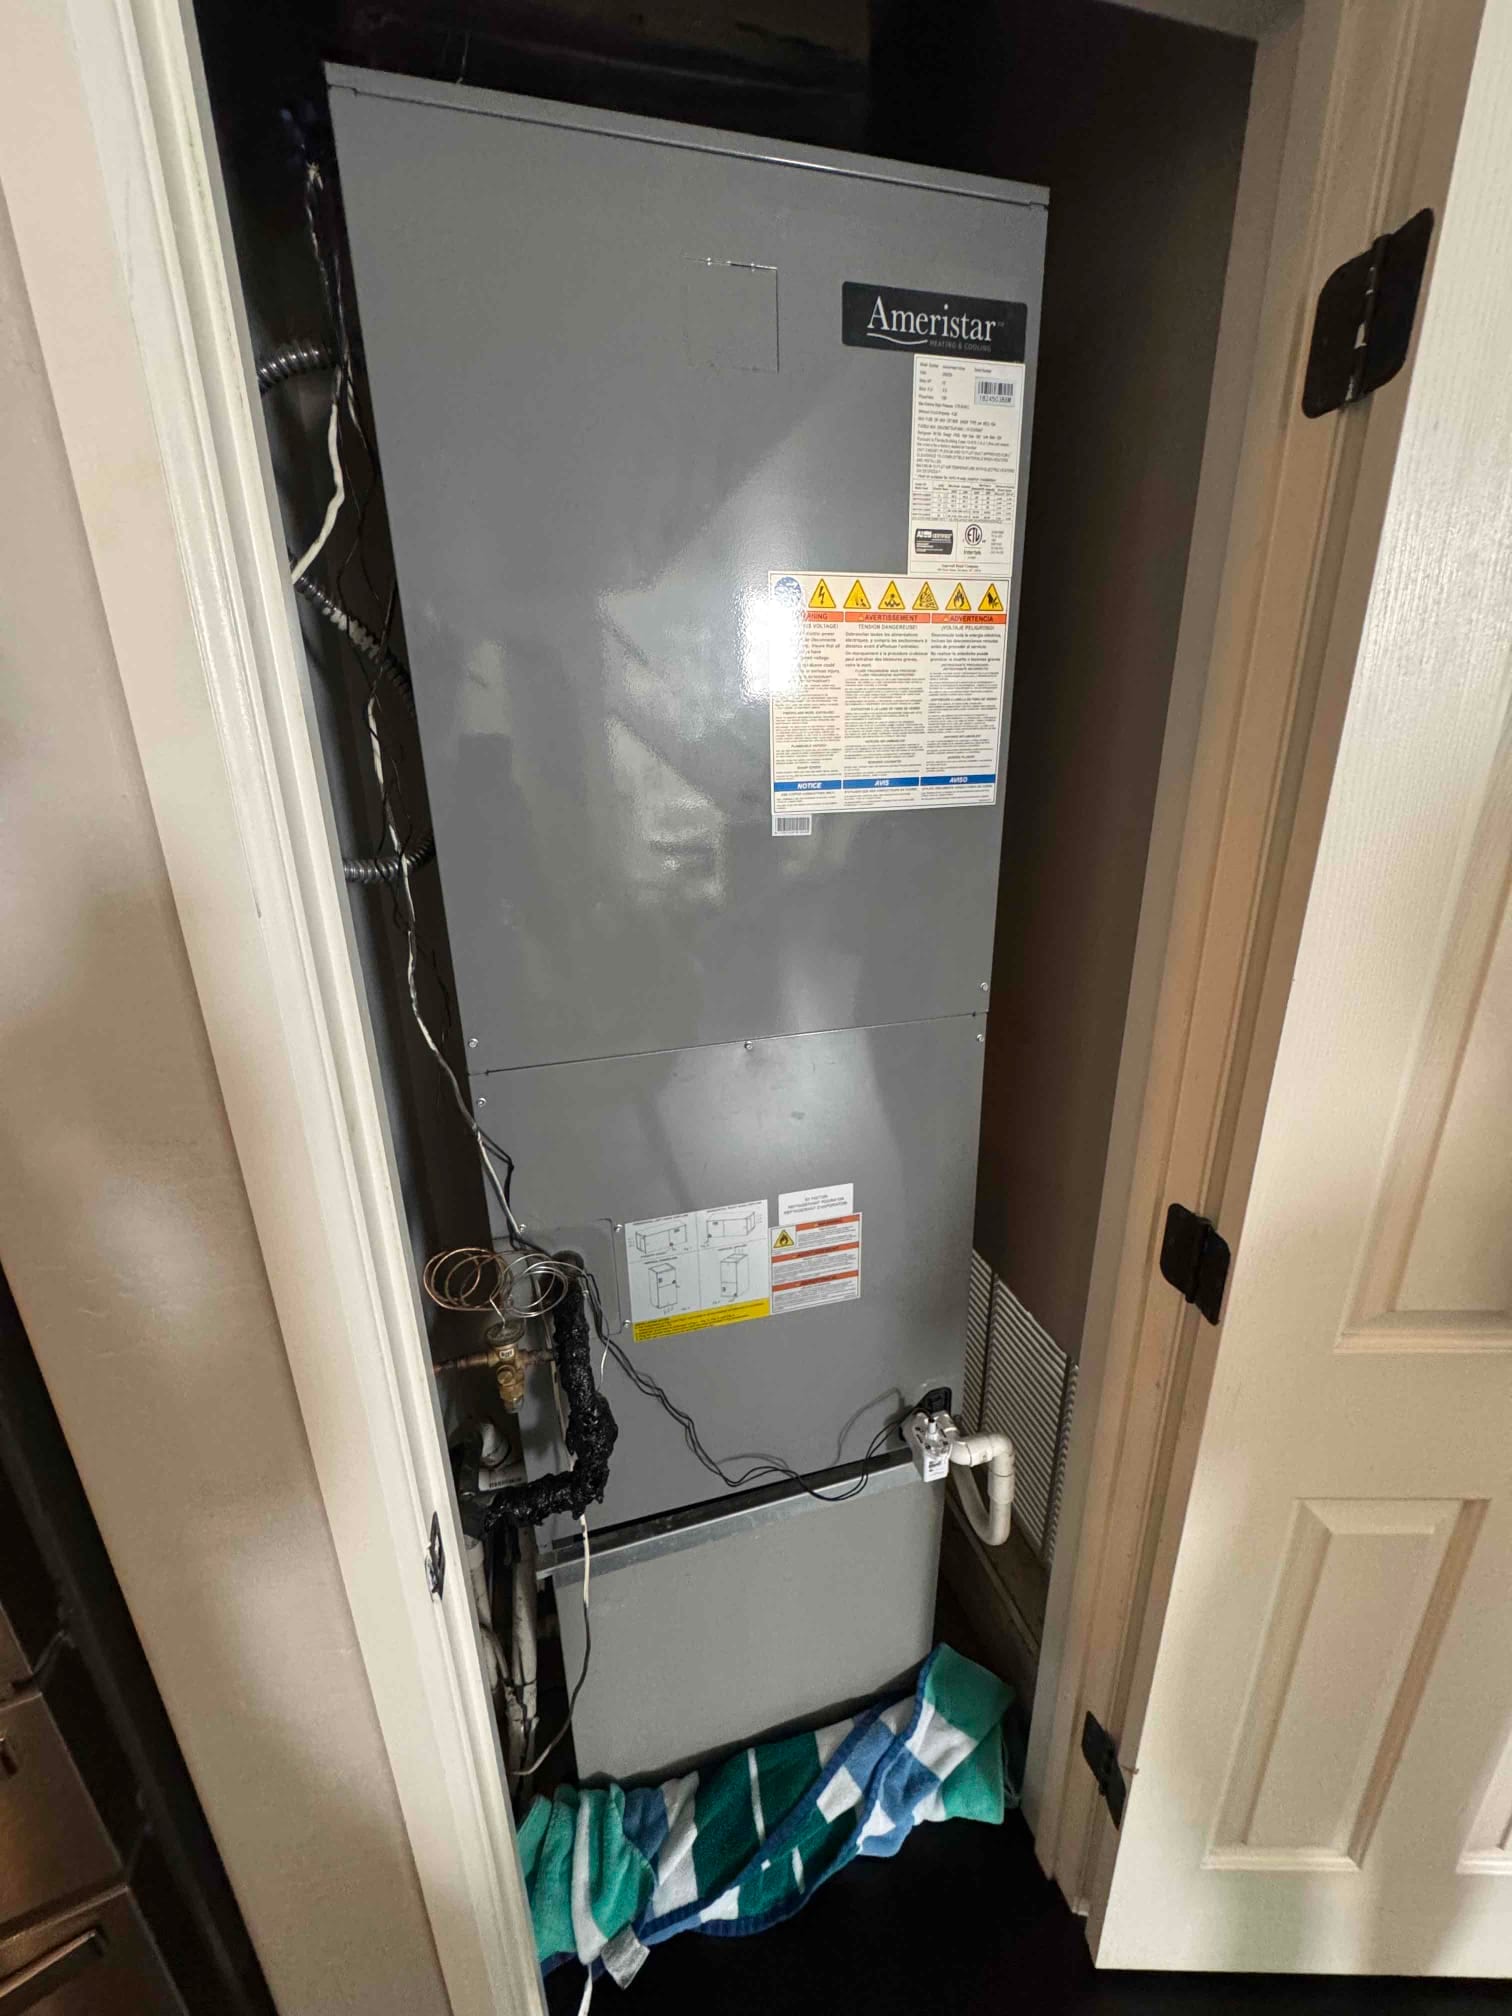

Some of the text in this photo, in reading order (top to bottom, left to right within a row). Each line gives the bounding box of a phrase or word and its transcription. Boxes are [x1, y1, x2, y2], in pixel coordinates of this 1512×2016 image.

[867, 295, 996, 341] Ameristar
[930, 340, 956, 349] HEATING
[964, 342, 991, 352] COOLING
[797, 782, 822, 790] NOTICE
